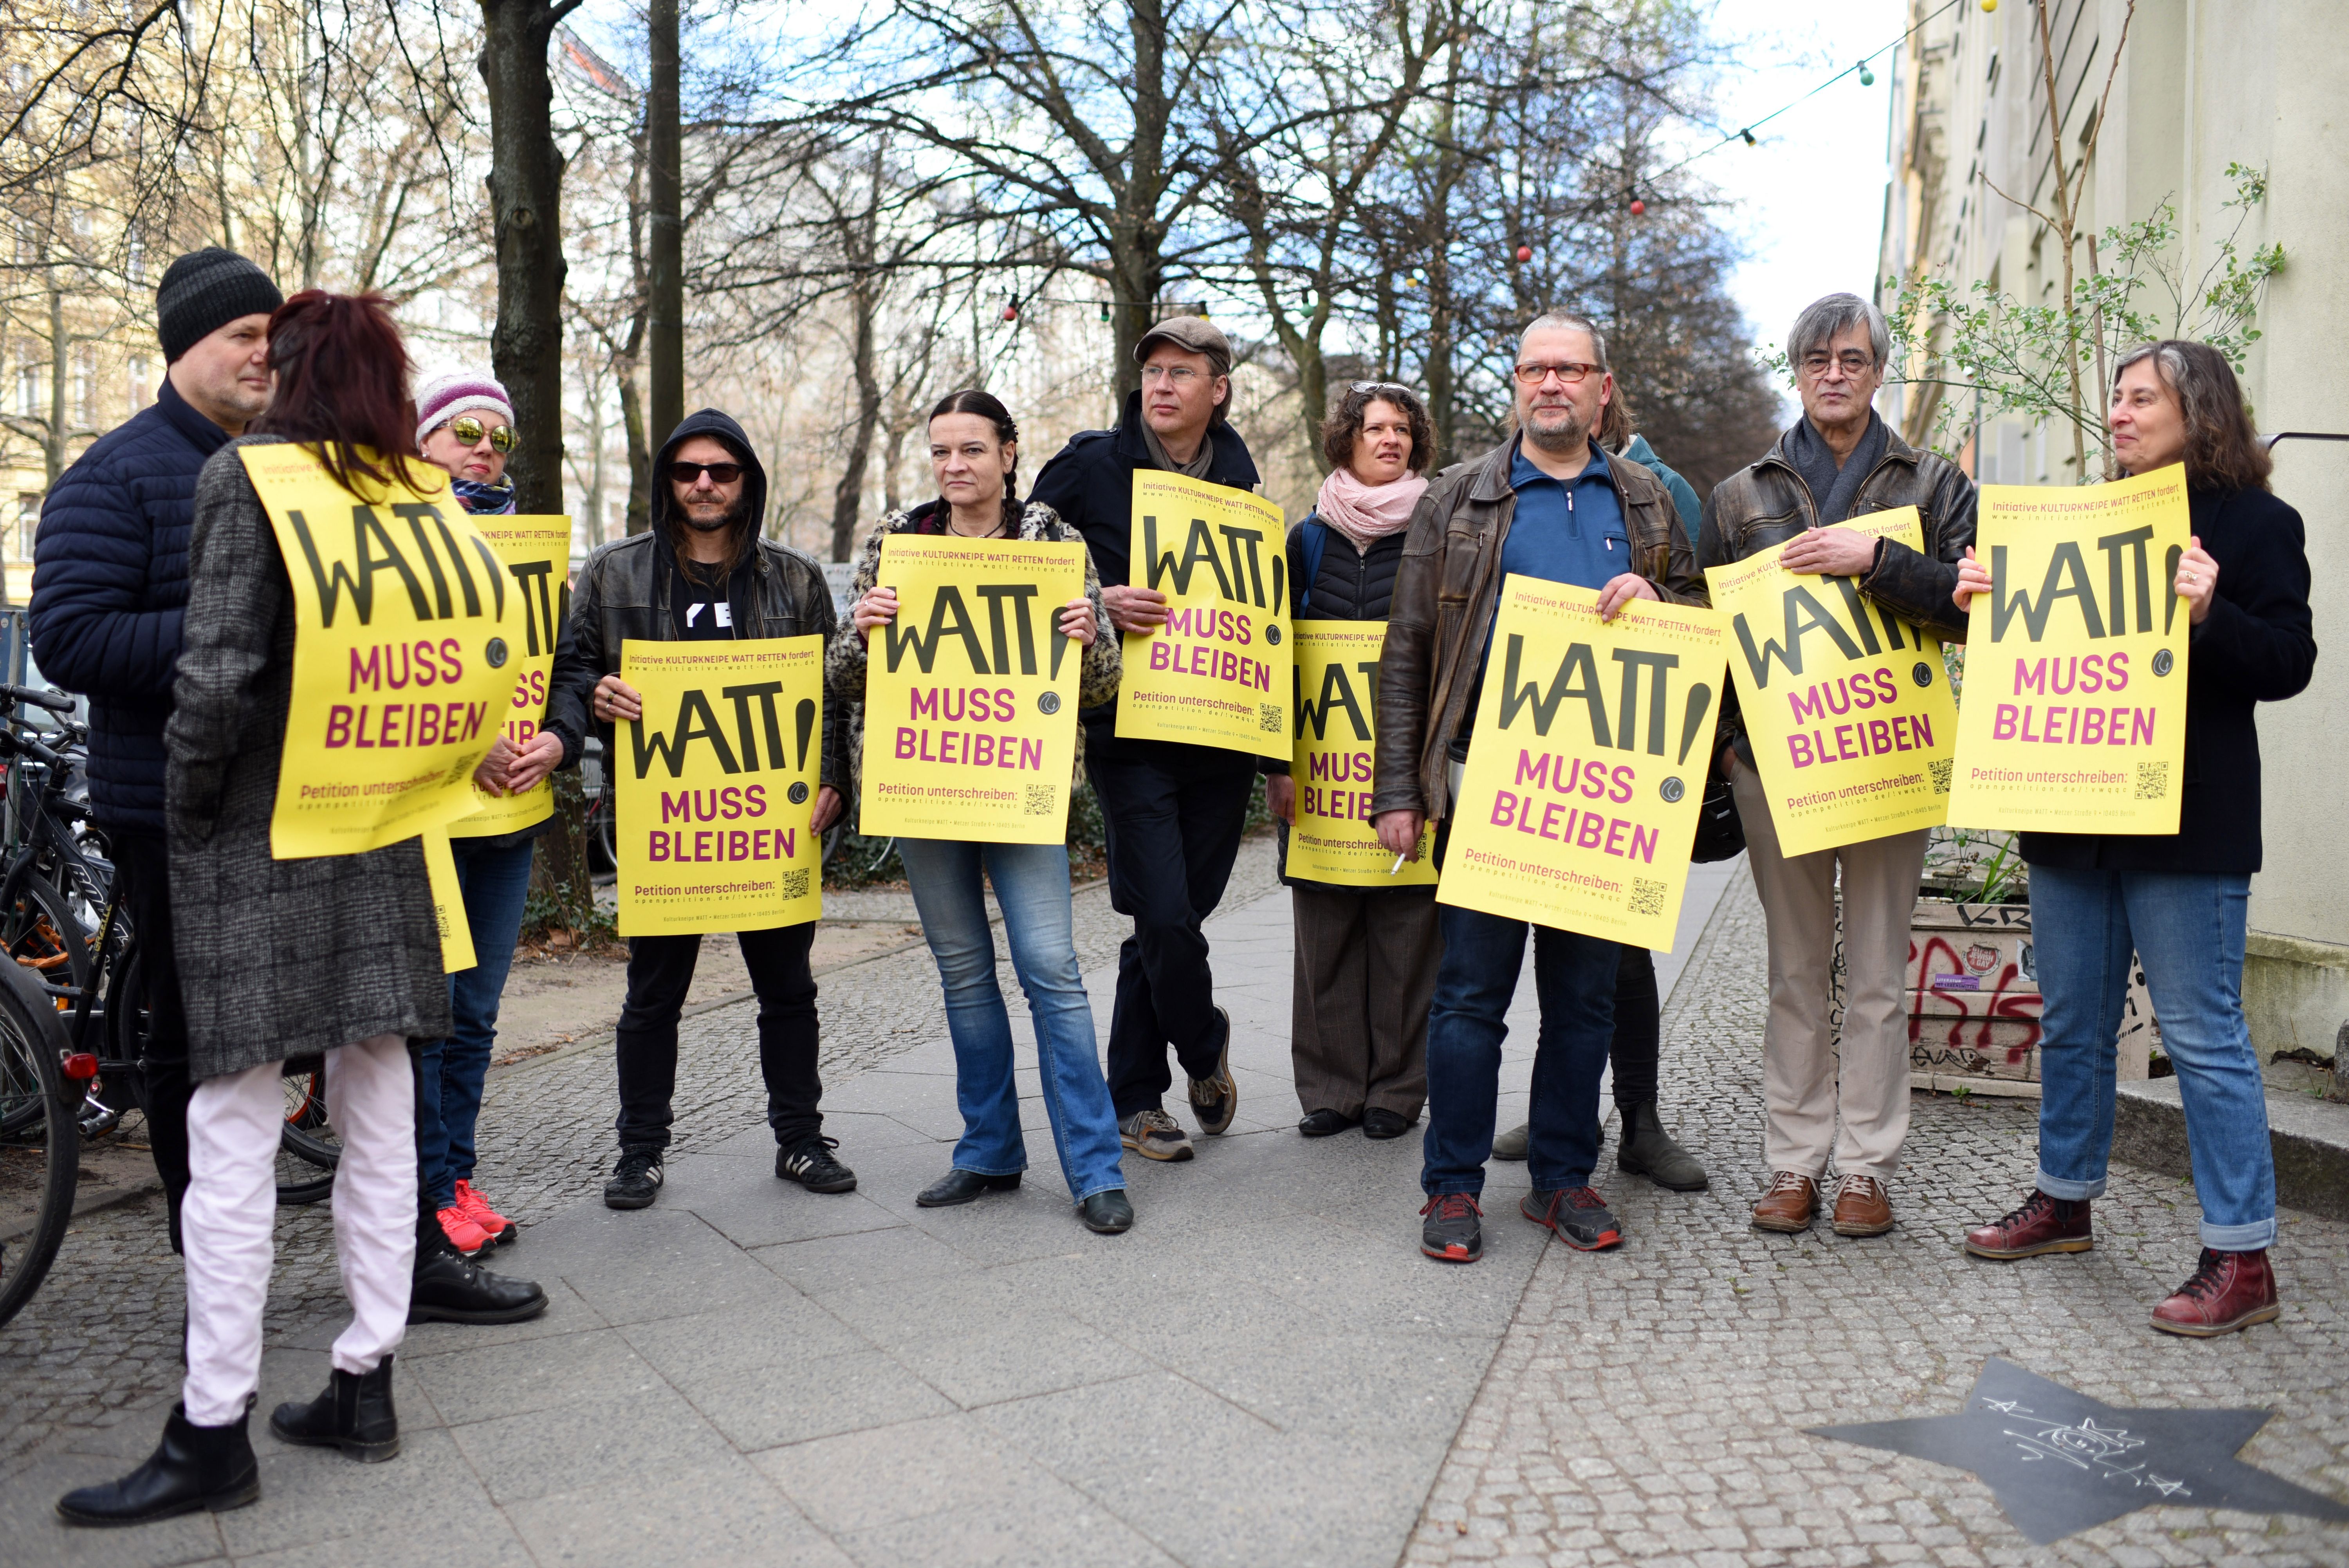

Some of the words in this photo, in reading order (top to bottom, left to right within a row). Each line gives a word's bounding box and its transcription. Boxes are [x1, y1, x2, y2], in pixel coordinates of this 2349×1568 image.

[263, 464, 312, 475] Initiative
[1143, 492, 1279, 530] www.initiative-watt-retten.de
[1144, 482, 1176, 492] Initiative
[1178, 486, 1223, 504] KULTURKNEIPE
[1225, 500, 1243, 508] WATT
[1245, 503, 1264, 516] RETTEN
[1265, 511, 1279, 524] fordert
[1992, 496, 2179, 520] www.initiative-watt-retten.de
[1993, 502, 2037, 512] Initiative
[2041, 500, 2108, 512] KULTURKNEIPE
[2111, 496, 2130, 507] WATT
[2132, 489, 2155, 503] RETTEN
[2157, 484, 2179, 497] fordert
[888, 559, 1074, 573] www.initiative-watt-retten.de
[889, 549, 920, 557] Initiative
[923, 550, 984, 560] KULTURKNEIPE
[987, 554, 1010, 562] WATT
[1012, 555, 1043, 564] RETTEN
[1046, 557, 1074, 565] fordert
[1718, 570, 1756, 590] Initiative
[1881, 522, 1911, 535] fordert
[286, 501, 508, 668] WATT!
[1143, 516, 1284, 646] WATT!
[1515, 592, 1557, 607] Initiative
[1631, 614, 1656, 626] WATT
[1658, 619, 1690, 632] RETTEN
[1693, 624, 1721, 637] fordert
[1990, 524, 2183, 677] WATT!
[1165, 607, 1252, 646] MUSS
[349, 638, 462, 694] MUSS
[629, 660, 814, 671] www.initiative-watt-retten.de
[630, 655, 663, 664] Initiative
[666, 655, 729, 664] KULTURKNEIPE
[757, 653, 786, 661] RETTEN
[789, 651, 814, 659] fordert
[884, 584, 1070, 715] WATT!
[1149, 641, 1270, 693] BLEIBEN
[512, 670, 545, 708] SS
[2013, 652, 2130, 696] MUSS
[910, 687, 1016, 722] MUSS
[1134, 691, 1175, 703] Petition
[1179, 696, 1254, 716] unterschreiben:
[1787, 668, 1898, 725] MUSS
[325, 700, 487, 749] BLEIBEN
[1497, 633, 1712, 803] WATT!
[1993, 704, 2156, 746] BLEIBEN
[630, 681, 815, 805] WATT!
[895, 727, 1043, 771] BLEIBEN
[1786, 713, 1935, 769] BLEIBEN
[1310, 752, 1372, 782] MUS
[1514, 749, 1635, 804] MUSS
[1972, 768, 2022, 781] Petition
[2027, 770, 2127, 783] unterschreiben:
[301, 783, 359, 799] Petition
[661, 784, 767, 824] MUSS
[879, 783, 924, 796] Petition
[927, 787, 1017, 800] unterschreiben:
[1304, 786, 1373, 821] BLEIB
[1787, 791, 1836, 809] Petition
[1838, 774, 1924, 798] unterschreiben:
[649, 828, 795, 862] BLEIBEN
[1299, 833, 1321, 846] Petition
[1323, 839, 1386, 850] unterschreib
[1490, 789, 1660, 864] BLEIBEN
[1826, 822, 1856, 832] Kulturkneipe
[635, 884, 681, 896] Petition
[685, 881, 775, 895] unterschreiben:
[1465, 848, 1516, 870] Petition
[1520, 862, 1622, 893] unterschreiben:
[1489, 891, 1523, 903] Kulturkneipe
[1544, 903, 1562, 911] Metzer
[1594, 914, 1609, 922] 10405
[1611, 918, 1627, 926] Berlin
[1969, 952, 1994, 963] JEWISH
[1976, 959, 1990, 968] GAY
